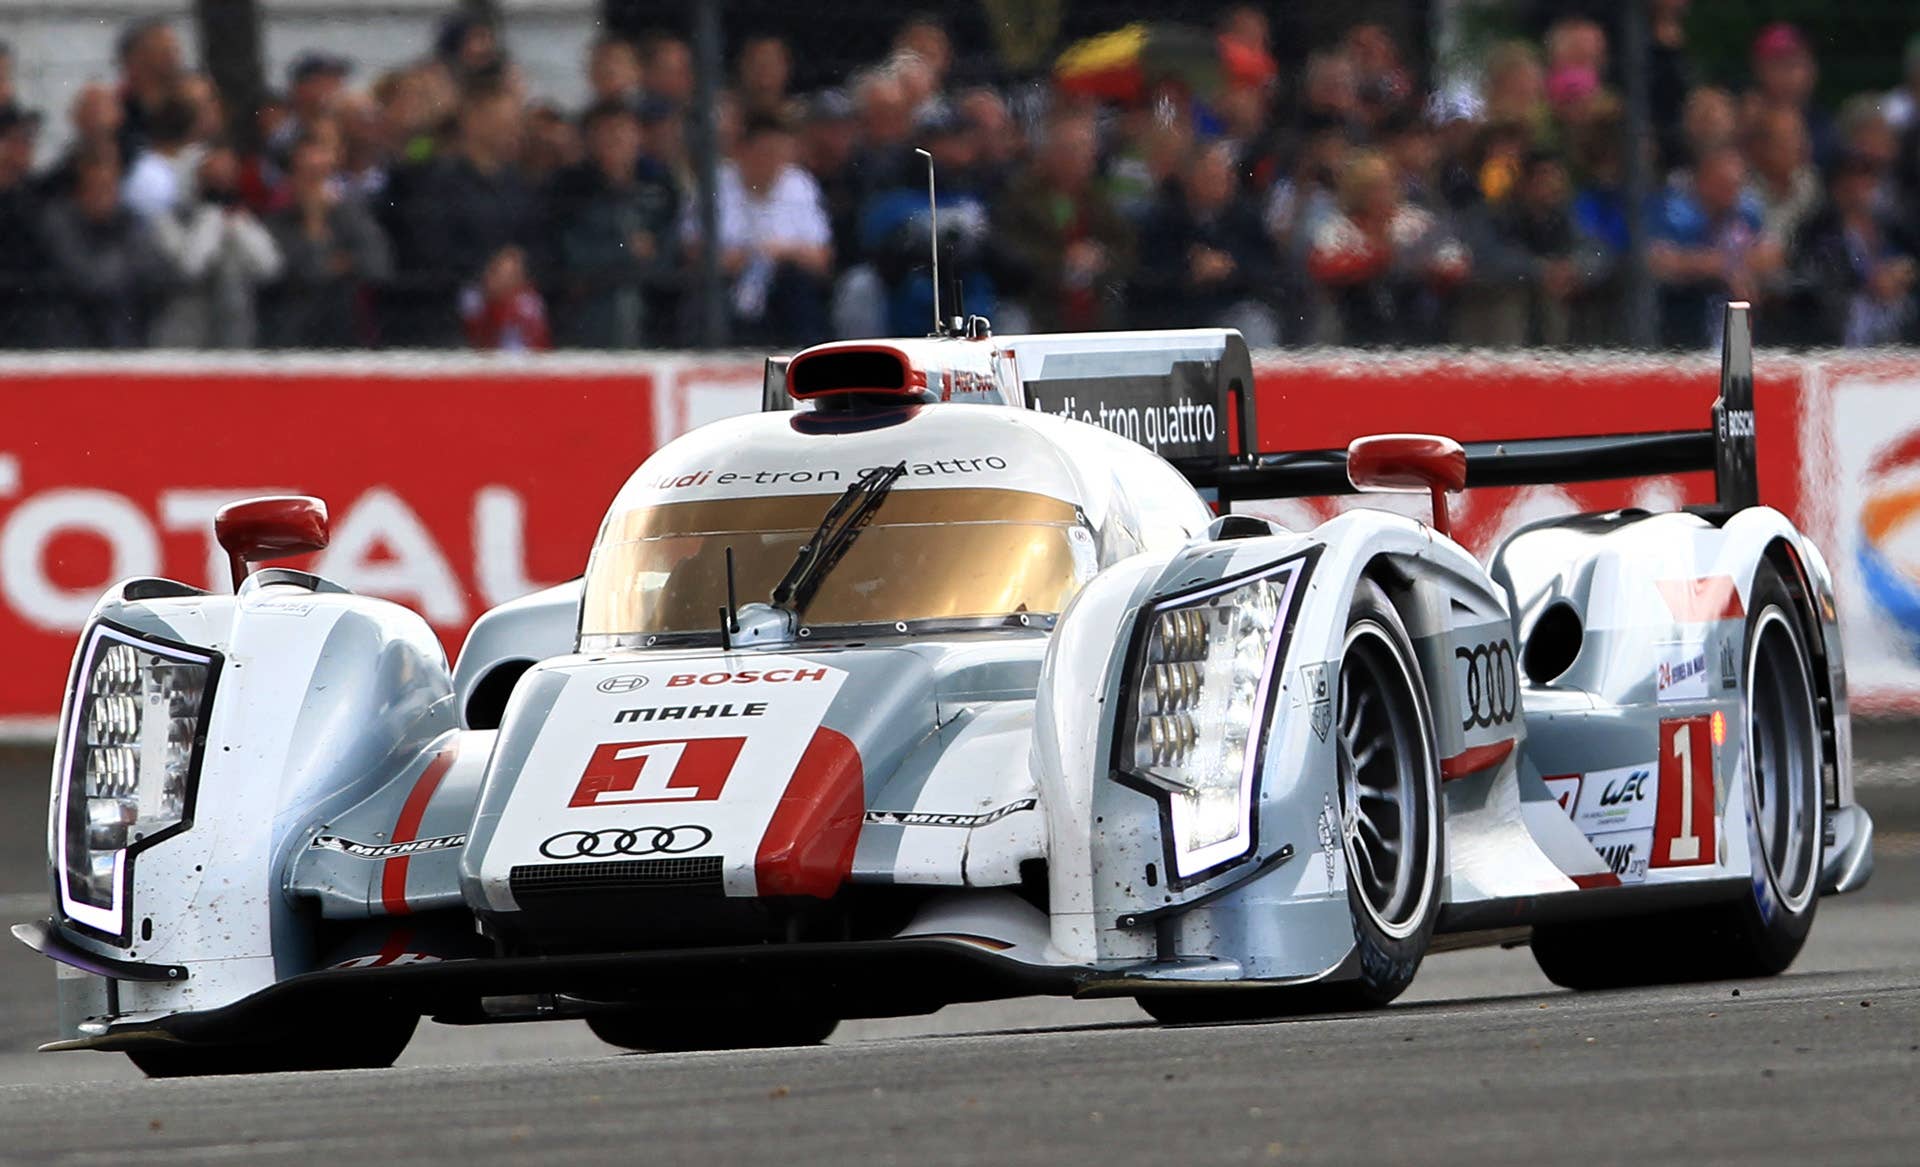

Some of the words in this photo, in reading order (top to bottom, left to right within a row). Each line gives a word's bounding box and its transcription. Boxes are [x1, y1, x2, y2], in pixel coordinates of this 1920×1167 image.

[1144, 397, 1215, 455] quattro
[1729, 410, 1754, 436] BOSCH
[717, 470, 839, 484] e-tron
[666, 668, 828, 688] BOSCH
[1659, 662, 1671, 690] 24
[613, 702, 769, 724] MAHLE
[594, 742, 700, 803] 1
[1599, 770, 1650, 806] WEC
[1669, 724, 1700, 861] 1
[903, 800, 1031, 825] MICHELIN
